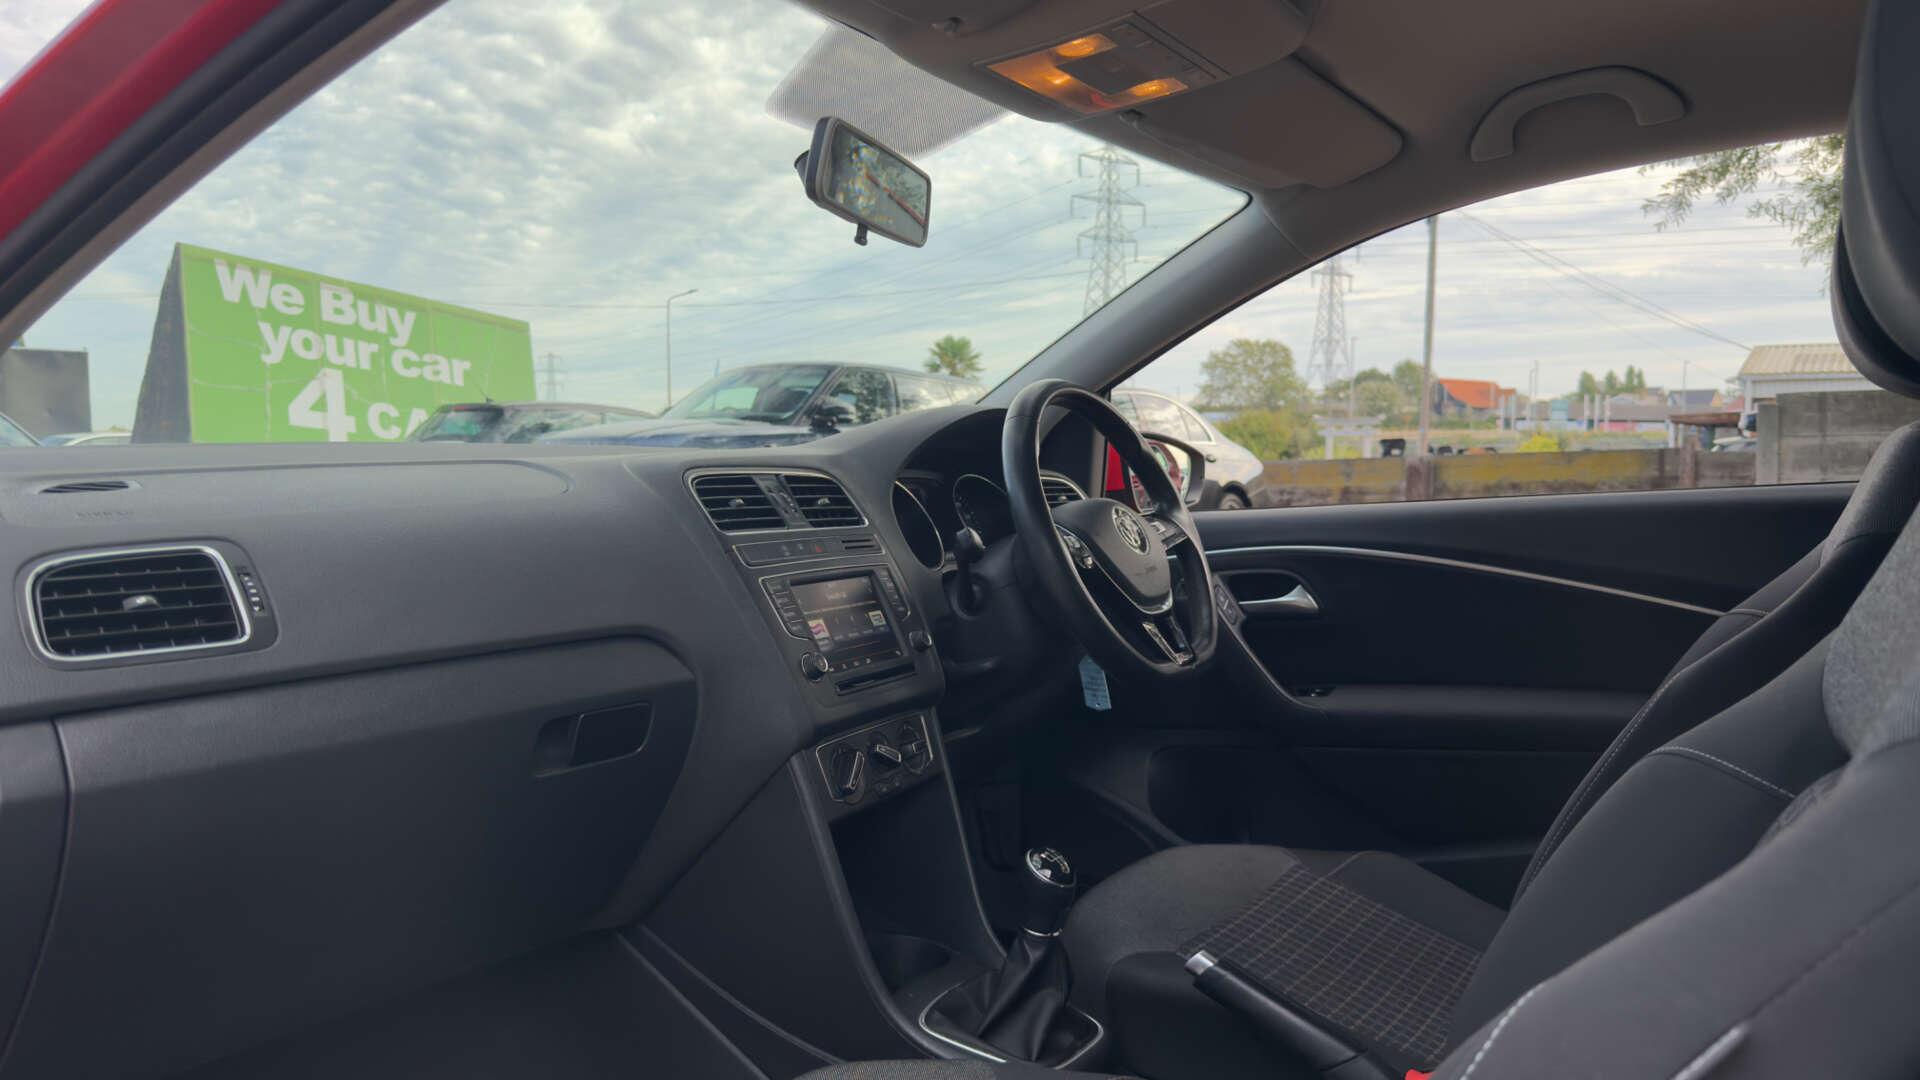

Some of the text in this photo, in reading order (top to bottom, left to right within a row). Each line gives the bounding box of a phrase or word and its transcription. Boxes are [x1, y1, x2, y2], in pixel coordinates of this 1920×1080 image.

[215, 260, 416, 347] We Buy
[258, 321, 471, 387] your car
[288, 368, 357, 442] 4
